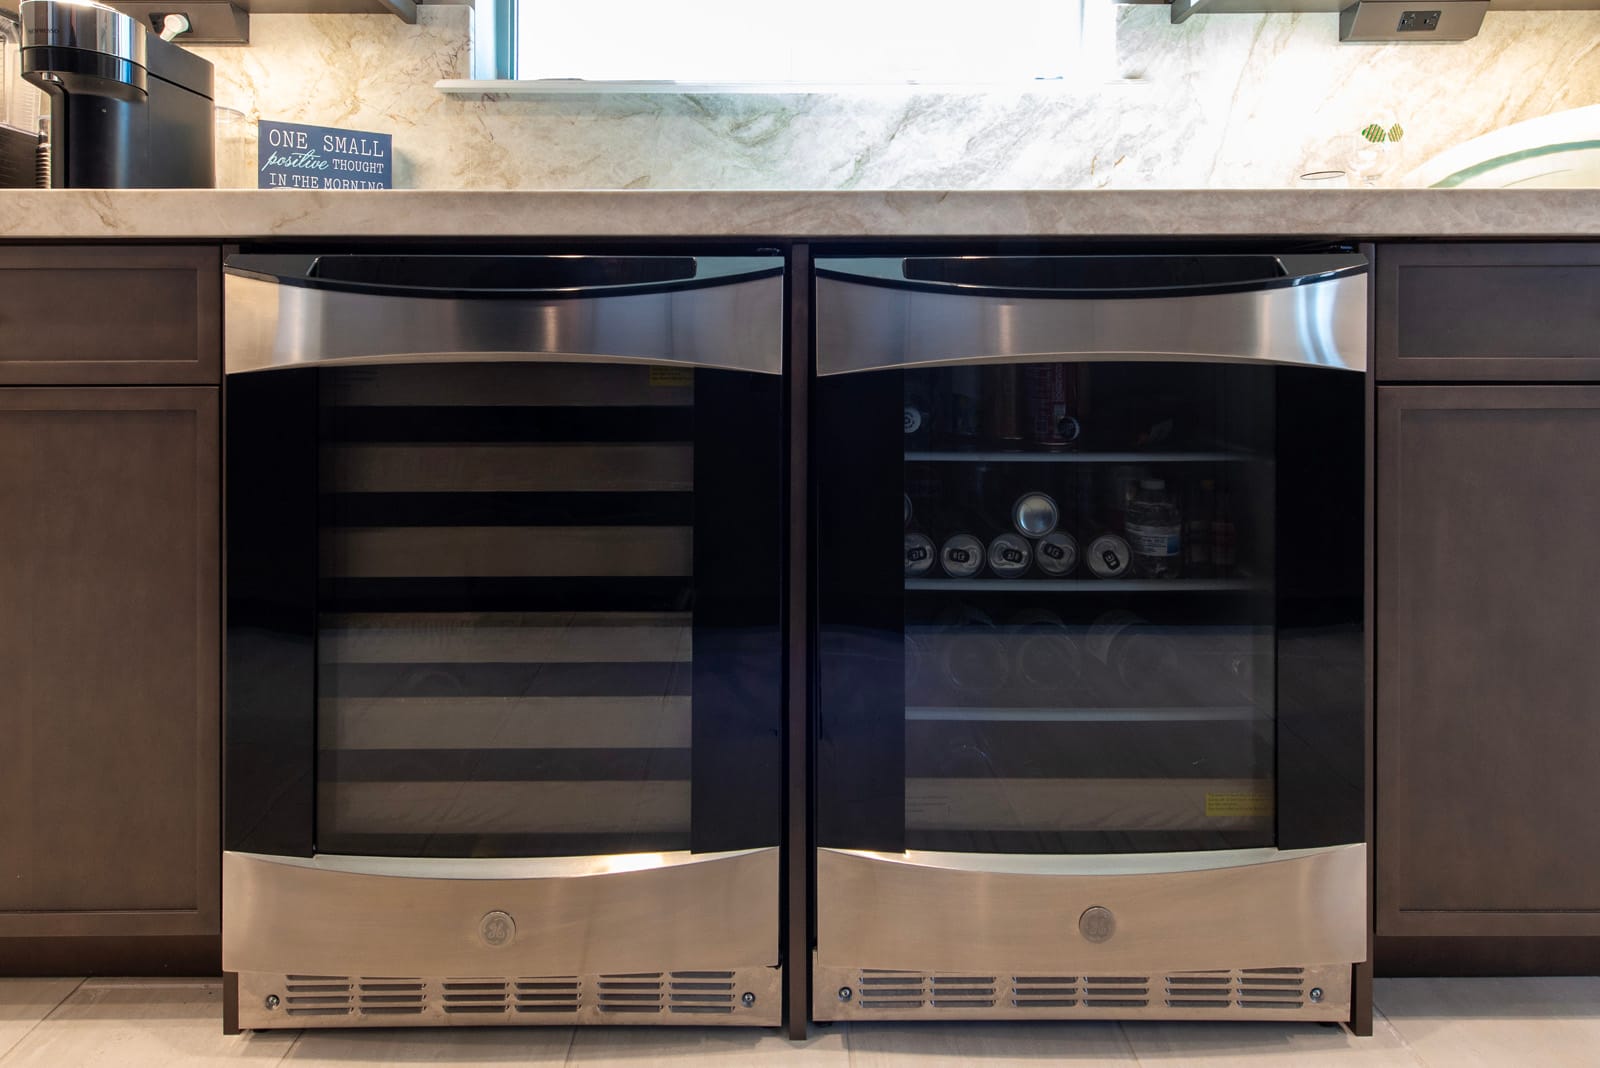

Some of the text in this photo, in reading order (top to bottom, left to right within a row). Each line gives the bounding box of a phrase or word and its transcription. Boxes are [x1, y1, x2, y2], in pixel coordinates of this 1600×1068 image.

[269, 129, 384, 157] ONE SMALL
[261, 149, 384, 174] positive THOUGHT
[269, 173, 287, 186] IN
[292, 175, 319, 189] THE
